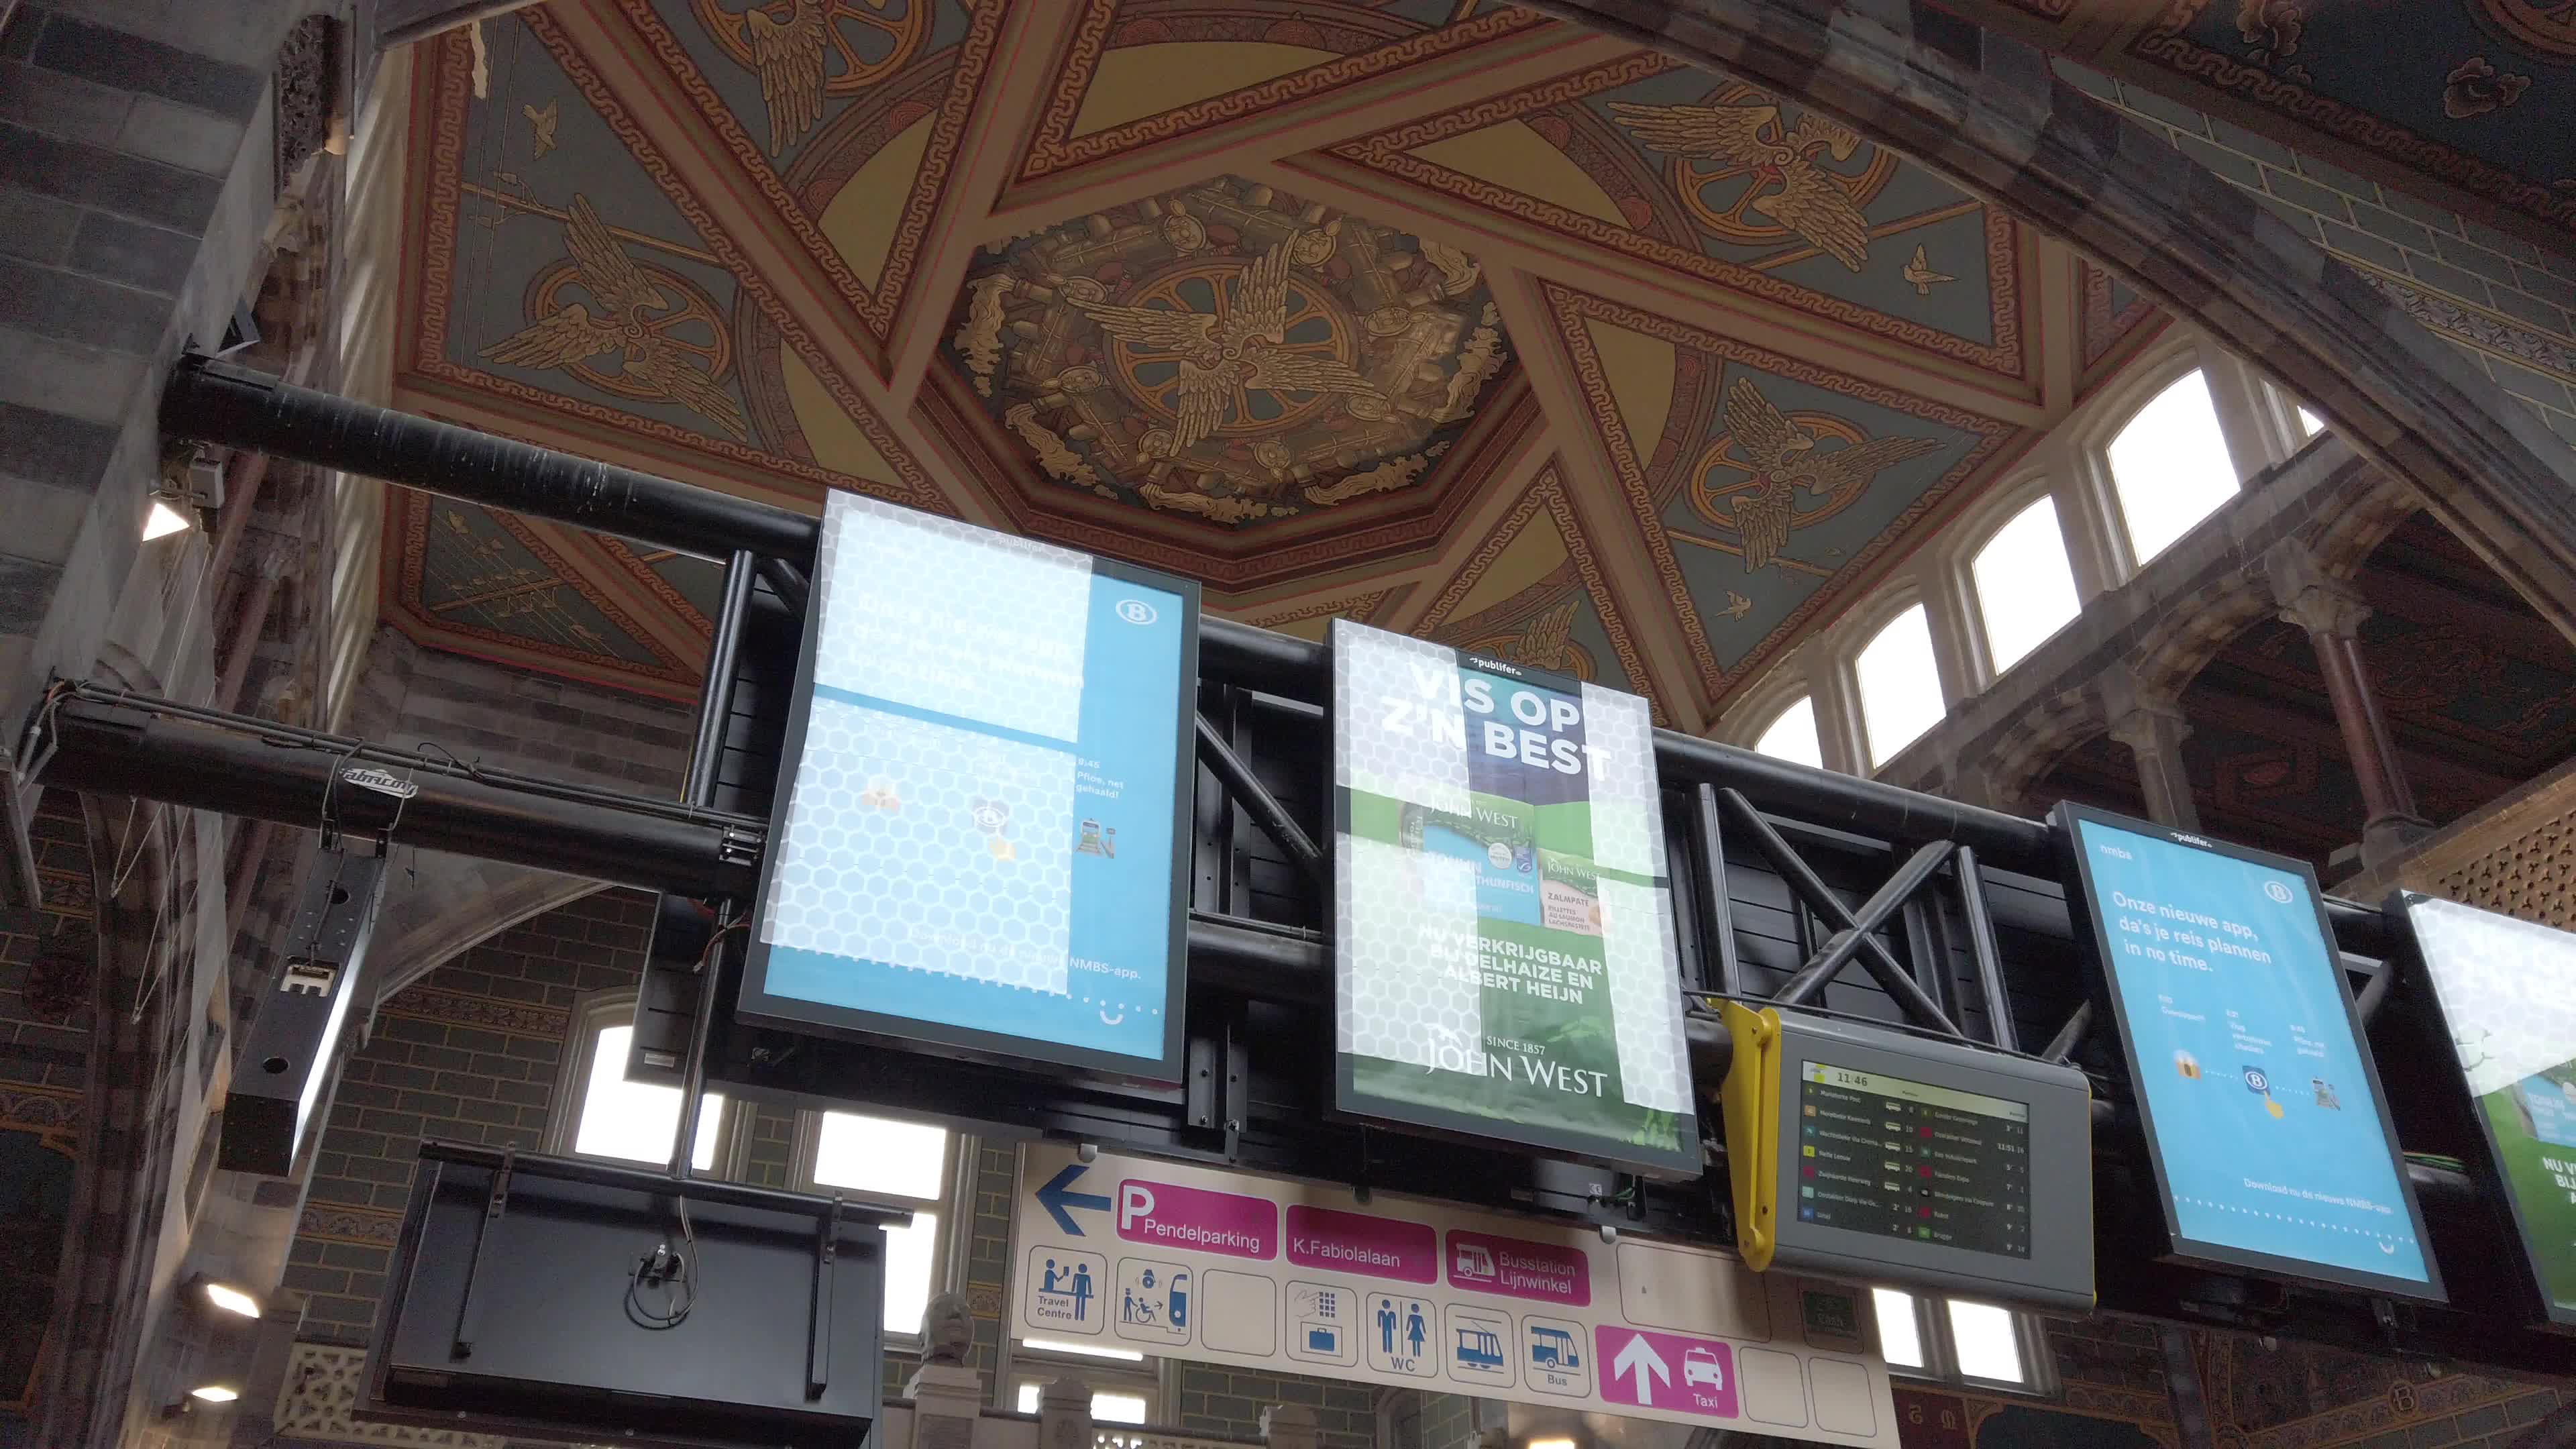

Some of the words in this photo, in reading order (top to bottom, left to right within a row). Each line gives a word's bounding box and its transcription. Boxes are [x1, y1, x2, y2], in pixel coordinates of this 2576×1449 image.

[1478, 658, 1515, 675] publifer
[1409, 661, 1495, 714] VIS
[1510, 690, 1580, 733] OP
[1382, 695, 1466, 751] Z'N
[1484, 720, 1611, 782] BEST
[1476, 807, 1519, 829] WEST
[2100, 844, 2133, 861] nmbs
[2178, 834, 2208, 848] publifer
[1547, 859, 1574, 875] JOHN
[1576, 868, 1599, 881] WEST
[2112, 890, 2156, 914] Onze
[2159, 904, 2218, 929] nieuwe
[2222, 920, 2259, 941] app,
[2119, 916, 2151, 935] da's
[2155, 923, 2169, 942] je
[2174, 929, 2204, 949] reis
[2208, 937, 2271, 964] plannen
[1454, 932, 1602, 975] VERKRIJGBAAR
[2125, 939, 2141, 957] in
[2146, 946, 2166, 962] no
[2169, 950, 2214, 973] time.
[1070, 957, 1142, 981] NMBS-app.
[1466, 953, 1563, 983] DELHAIZE
[1568, 971, 1593, 989] EN
[1444, 965, 1520, 992] ALBERT
[1527, 980, 1583, 1005] HEIJN
[1487, 1035, 1520, 1051] SINCE
[1522, 1042, 1546, 1055] 1857
[1426, 1036, 1513, 1082] JOHN
[1519, 1055, 1608, 1097] WEST
[1837, 1071, 1868, 1087] 11:46
[2542, 1157, 2563, 1172] NU
[2243, 1177, 2288, 1195] Download
[2290, 1189, 2300, 1198] nu
[2302, 1189, 2314, 1200] de
[1121, 1184, 1155, 1230] P
[1144, 1218, 1260, 1254] Pendelparking
[1293, 1237, 1401, 1269] K.Fabiolalaan
[1500, 1250, 1576, 1278] Busstation
[1500, 1270, 1572, 1295] Lijnwinkel
[1038, 1295, 1069, 1308] Travel
[1037, 1307, 1072, 1321] Centre
[1390, 1356, 1416, 1373] WC
[1547, 1374, 1568, 1387] Bus
[1693, 1393, 1719, 1409] Taxi
